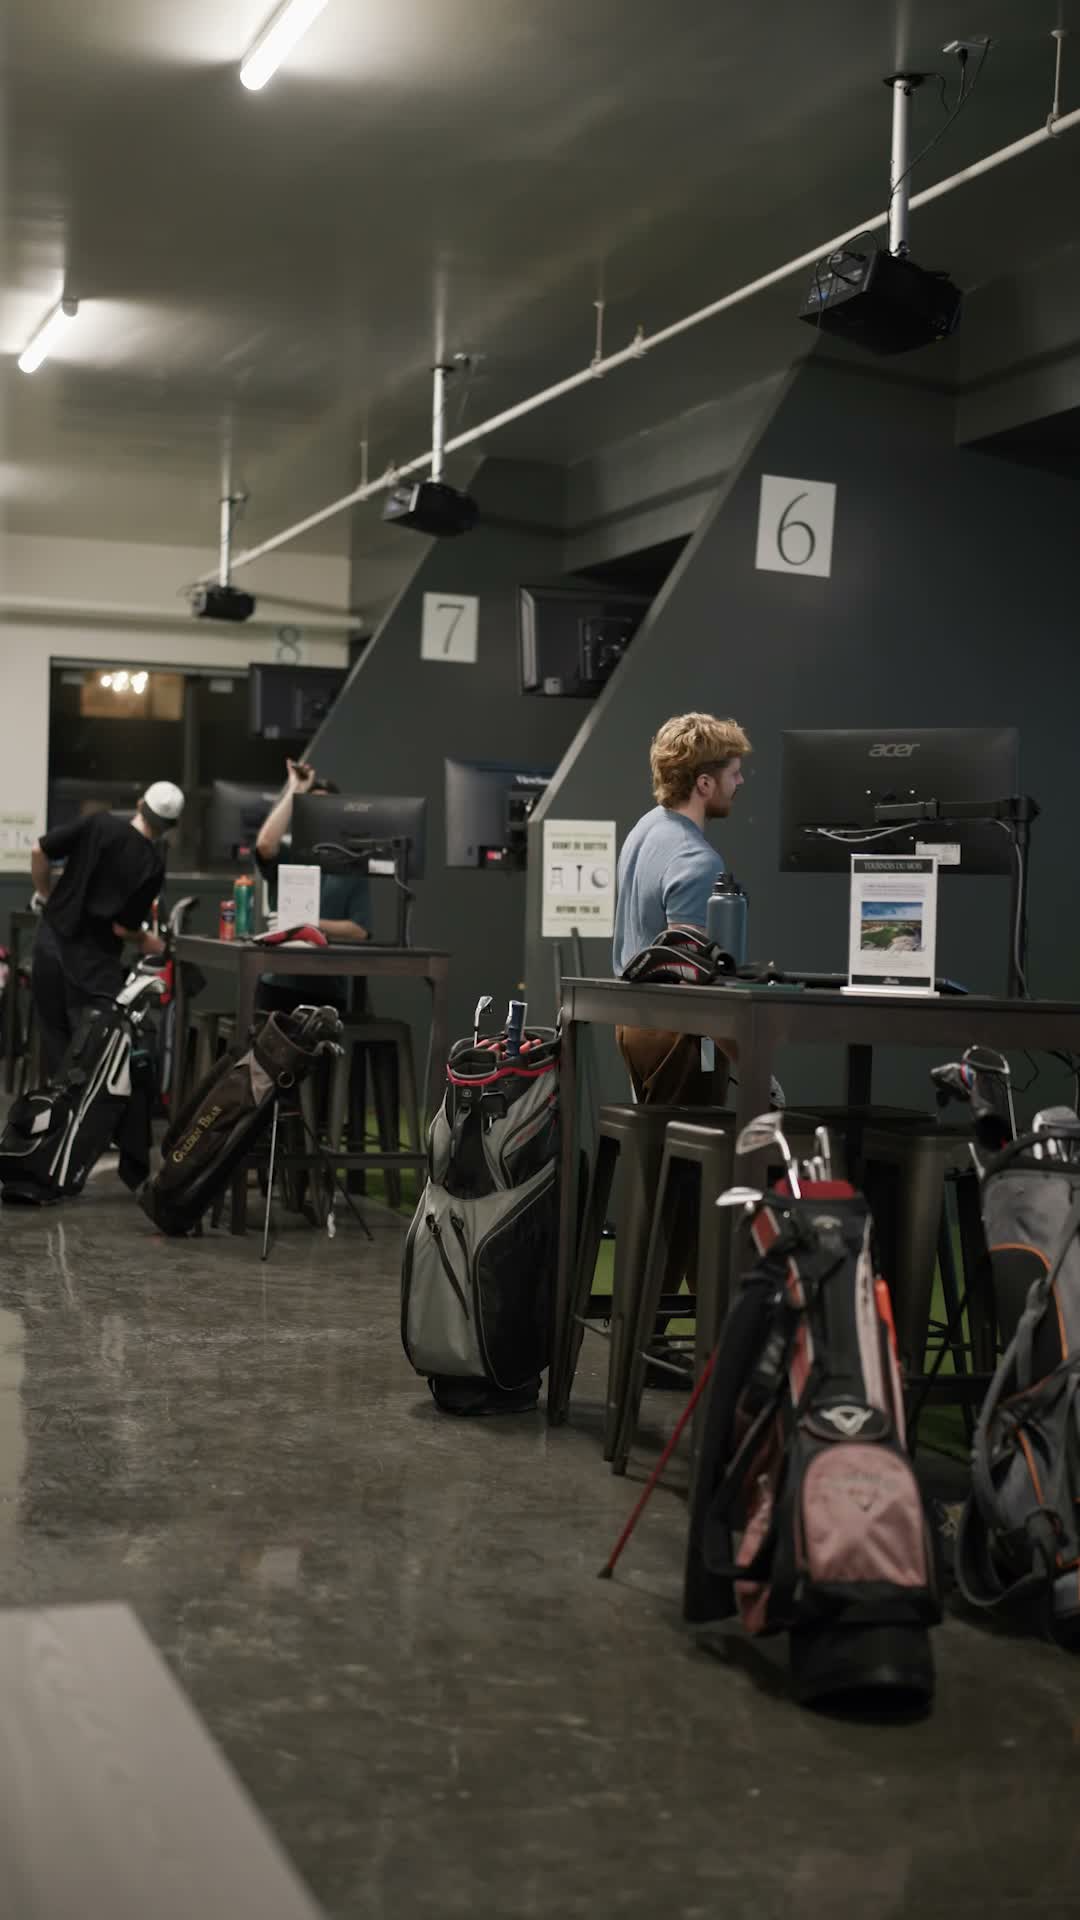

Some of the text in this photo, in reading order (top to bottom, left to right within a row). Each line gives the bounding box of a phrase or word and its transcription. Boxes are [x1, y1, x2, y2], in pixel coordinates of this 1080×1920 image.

[777, 492, 816, 566] 6
[277, 624, 302, 664] 8
[436, 602, 466, 654] 7
[868, 743, 921, 757] acer
